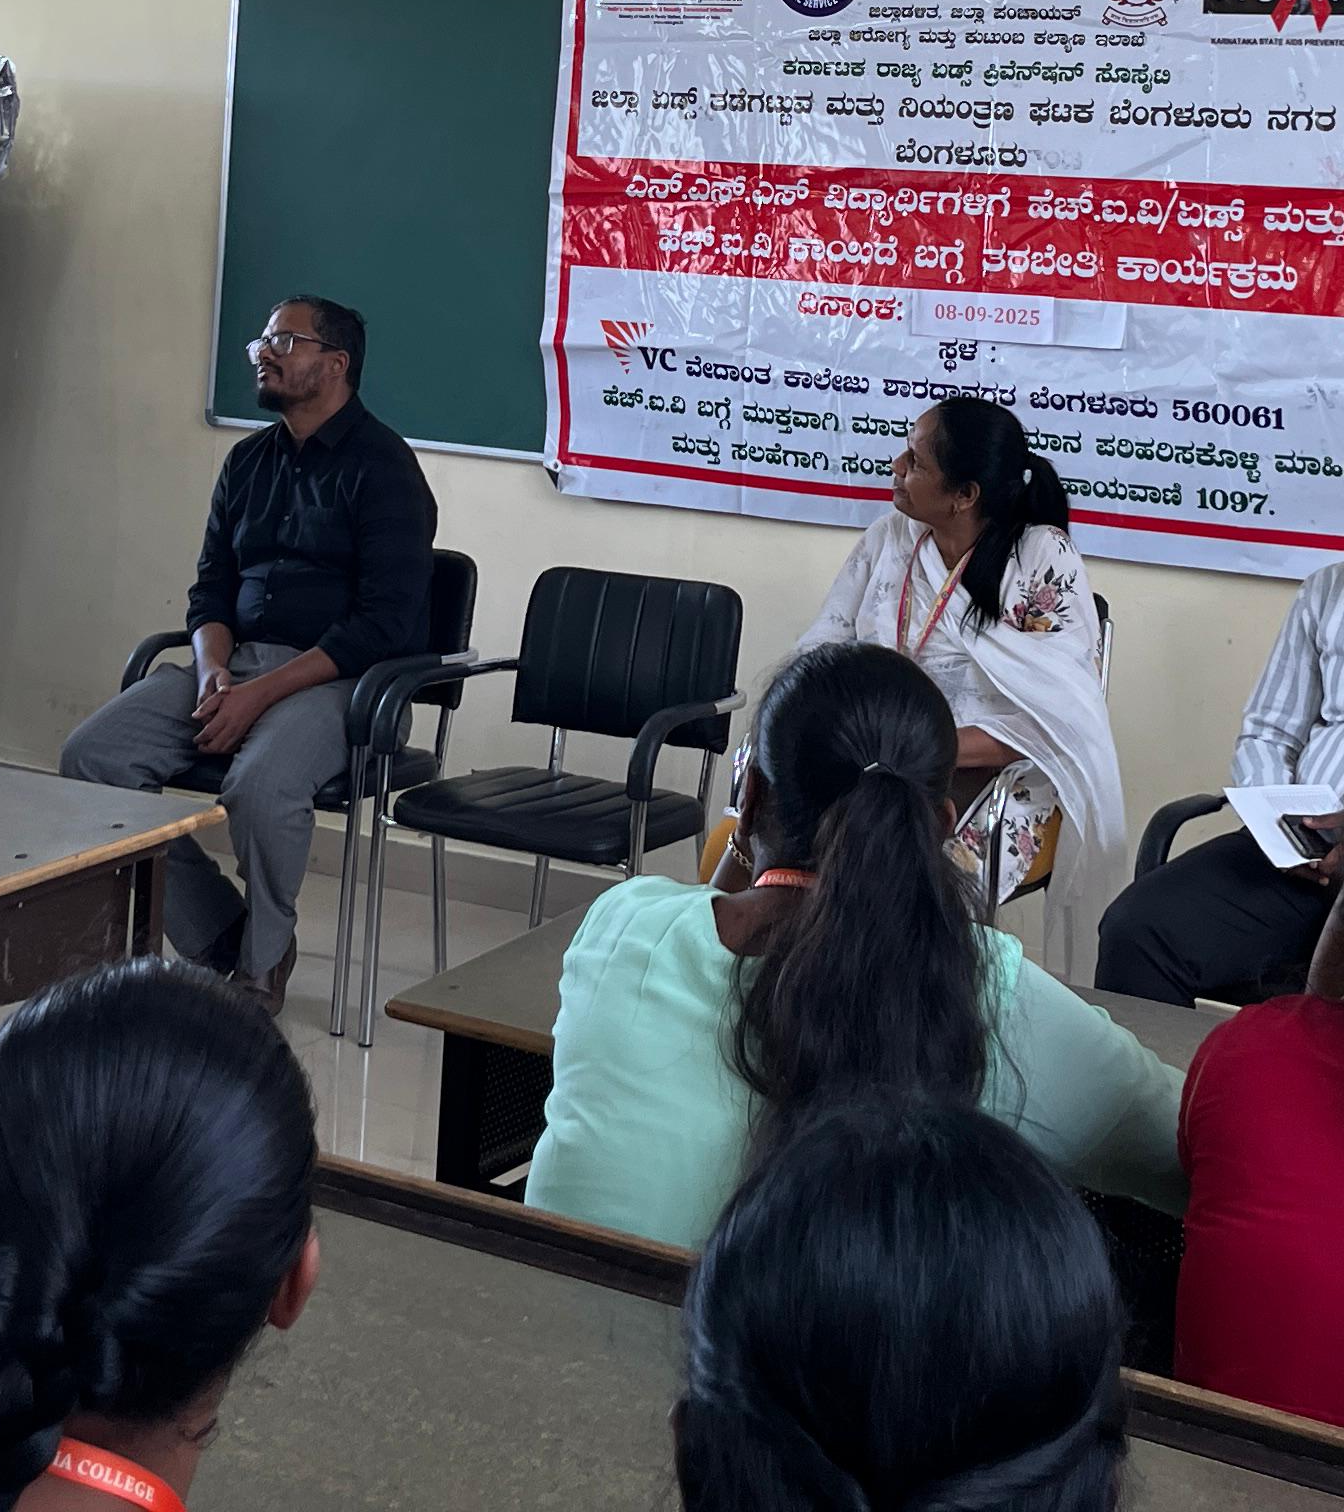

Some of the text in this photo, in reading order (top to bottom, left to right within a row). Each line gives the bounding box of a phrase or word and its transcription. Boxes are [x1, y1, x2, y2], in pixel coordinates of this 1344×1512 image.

[919, 28, 956, 49] ಮತ್ತು
[1034, 30, 1086, 53] ಕಲ್ಯಾಣ
[782, 56, 866, 77] ಕರ್ನಾಟಕ
[876, 61, 922, 88] ರಾಜ್ಯ
[710, 87, 813, 126] ತಡೆಗಟ್ಟುವ
[826, 91, 885, 126] ಮತ್ತು
[898, 94, 1014, 128] ನಿಯಂತ್ರಣ
[1029, 97, 1095, 126] ಘಟಕ
[1109, 99, 1252, 130] ಬೆಂಗಳೂರು
[1267, 104, 1336, 132] ನಗರ
[895, 138, 1028, 168] ಬೆಂಗಳೂರು
[914, 239, 966, 284] ಬಗ್ಗೆ
[982, 242, 1099, 277] ತರಬೇತಿ
[1116, 253, 1298, 299] ಕಾರ್ಯಕ್ರಮ
[935, 303, 1041, 326] 08-09-2025
[637, 346, 678, 372] VC
[685, 355, 772, 385] ವೇದಾಂತ
[783, 367, 871, 395] ಕಾಲೇಜು
[1029, 386, 1158, 419] ಬೆಂಗಳೂರು
[1172, 399, 1285, 430] 560061
[697, 397, 732, 430] ಬಗ್ಗೆ
[742, 401, 840, 434] ಮುಕ್ತವಾಗಿ
[851, 411, 915, 438] ಮಾತ
[671, 432, 721, 465] ಮತ್ತು
[731, 440, 830, 471] ಸಲಹೆಗಾಗಿ
[1196, 487, 1275, 516] 1097.
[77, 1459, 155, 1503] COLLEGE
